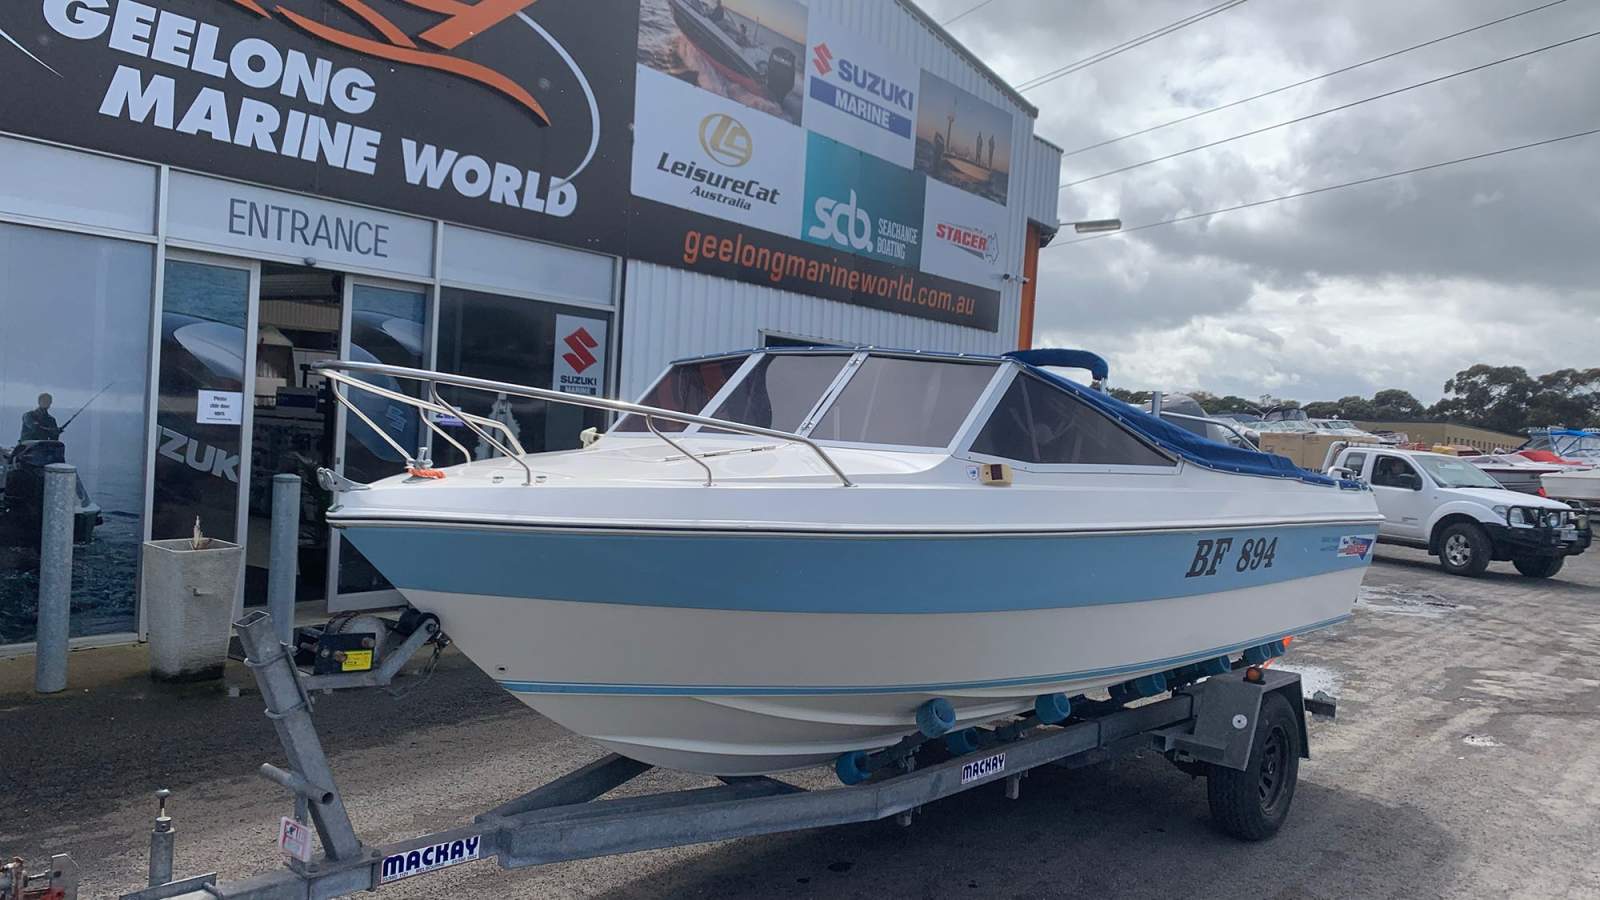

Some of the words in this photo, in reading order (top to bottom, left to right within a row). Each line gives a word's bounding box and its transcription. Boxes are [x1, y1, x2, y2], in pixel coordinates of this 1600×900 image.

[43, 0, 377, 114] GEELONG
[837, 58, 914, 112] SUZUKI
[835, 88, 891, 129] MARINE
[98, 64, 382, 175] MARINE
[401, 137, 578, 217] WORLD
[656, 151, 780, 205] LeisureCat
[690, 184, 752, 212] Australia
[228, 198, 389, 259] ENTRANCE
[876, 236, 906, 260] BOATING
[877, 217, 919, 246] SEACHANGE
[935, 222, 988, 252] STACER
[682, 229, 976, 316] geelongmarineworld.com.au
[559, 375, 597, 386] SUZUKI
[1184, 537, 1234, 578] BF
[1236, 536, 1279, 573] 894
[963, 754, 1006, 781] MACKAY
[382, 836, 480, 877] MACKAY
